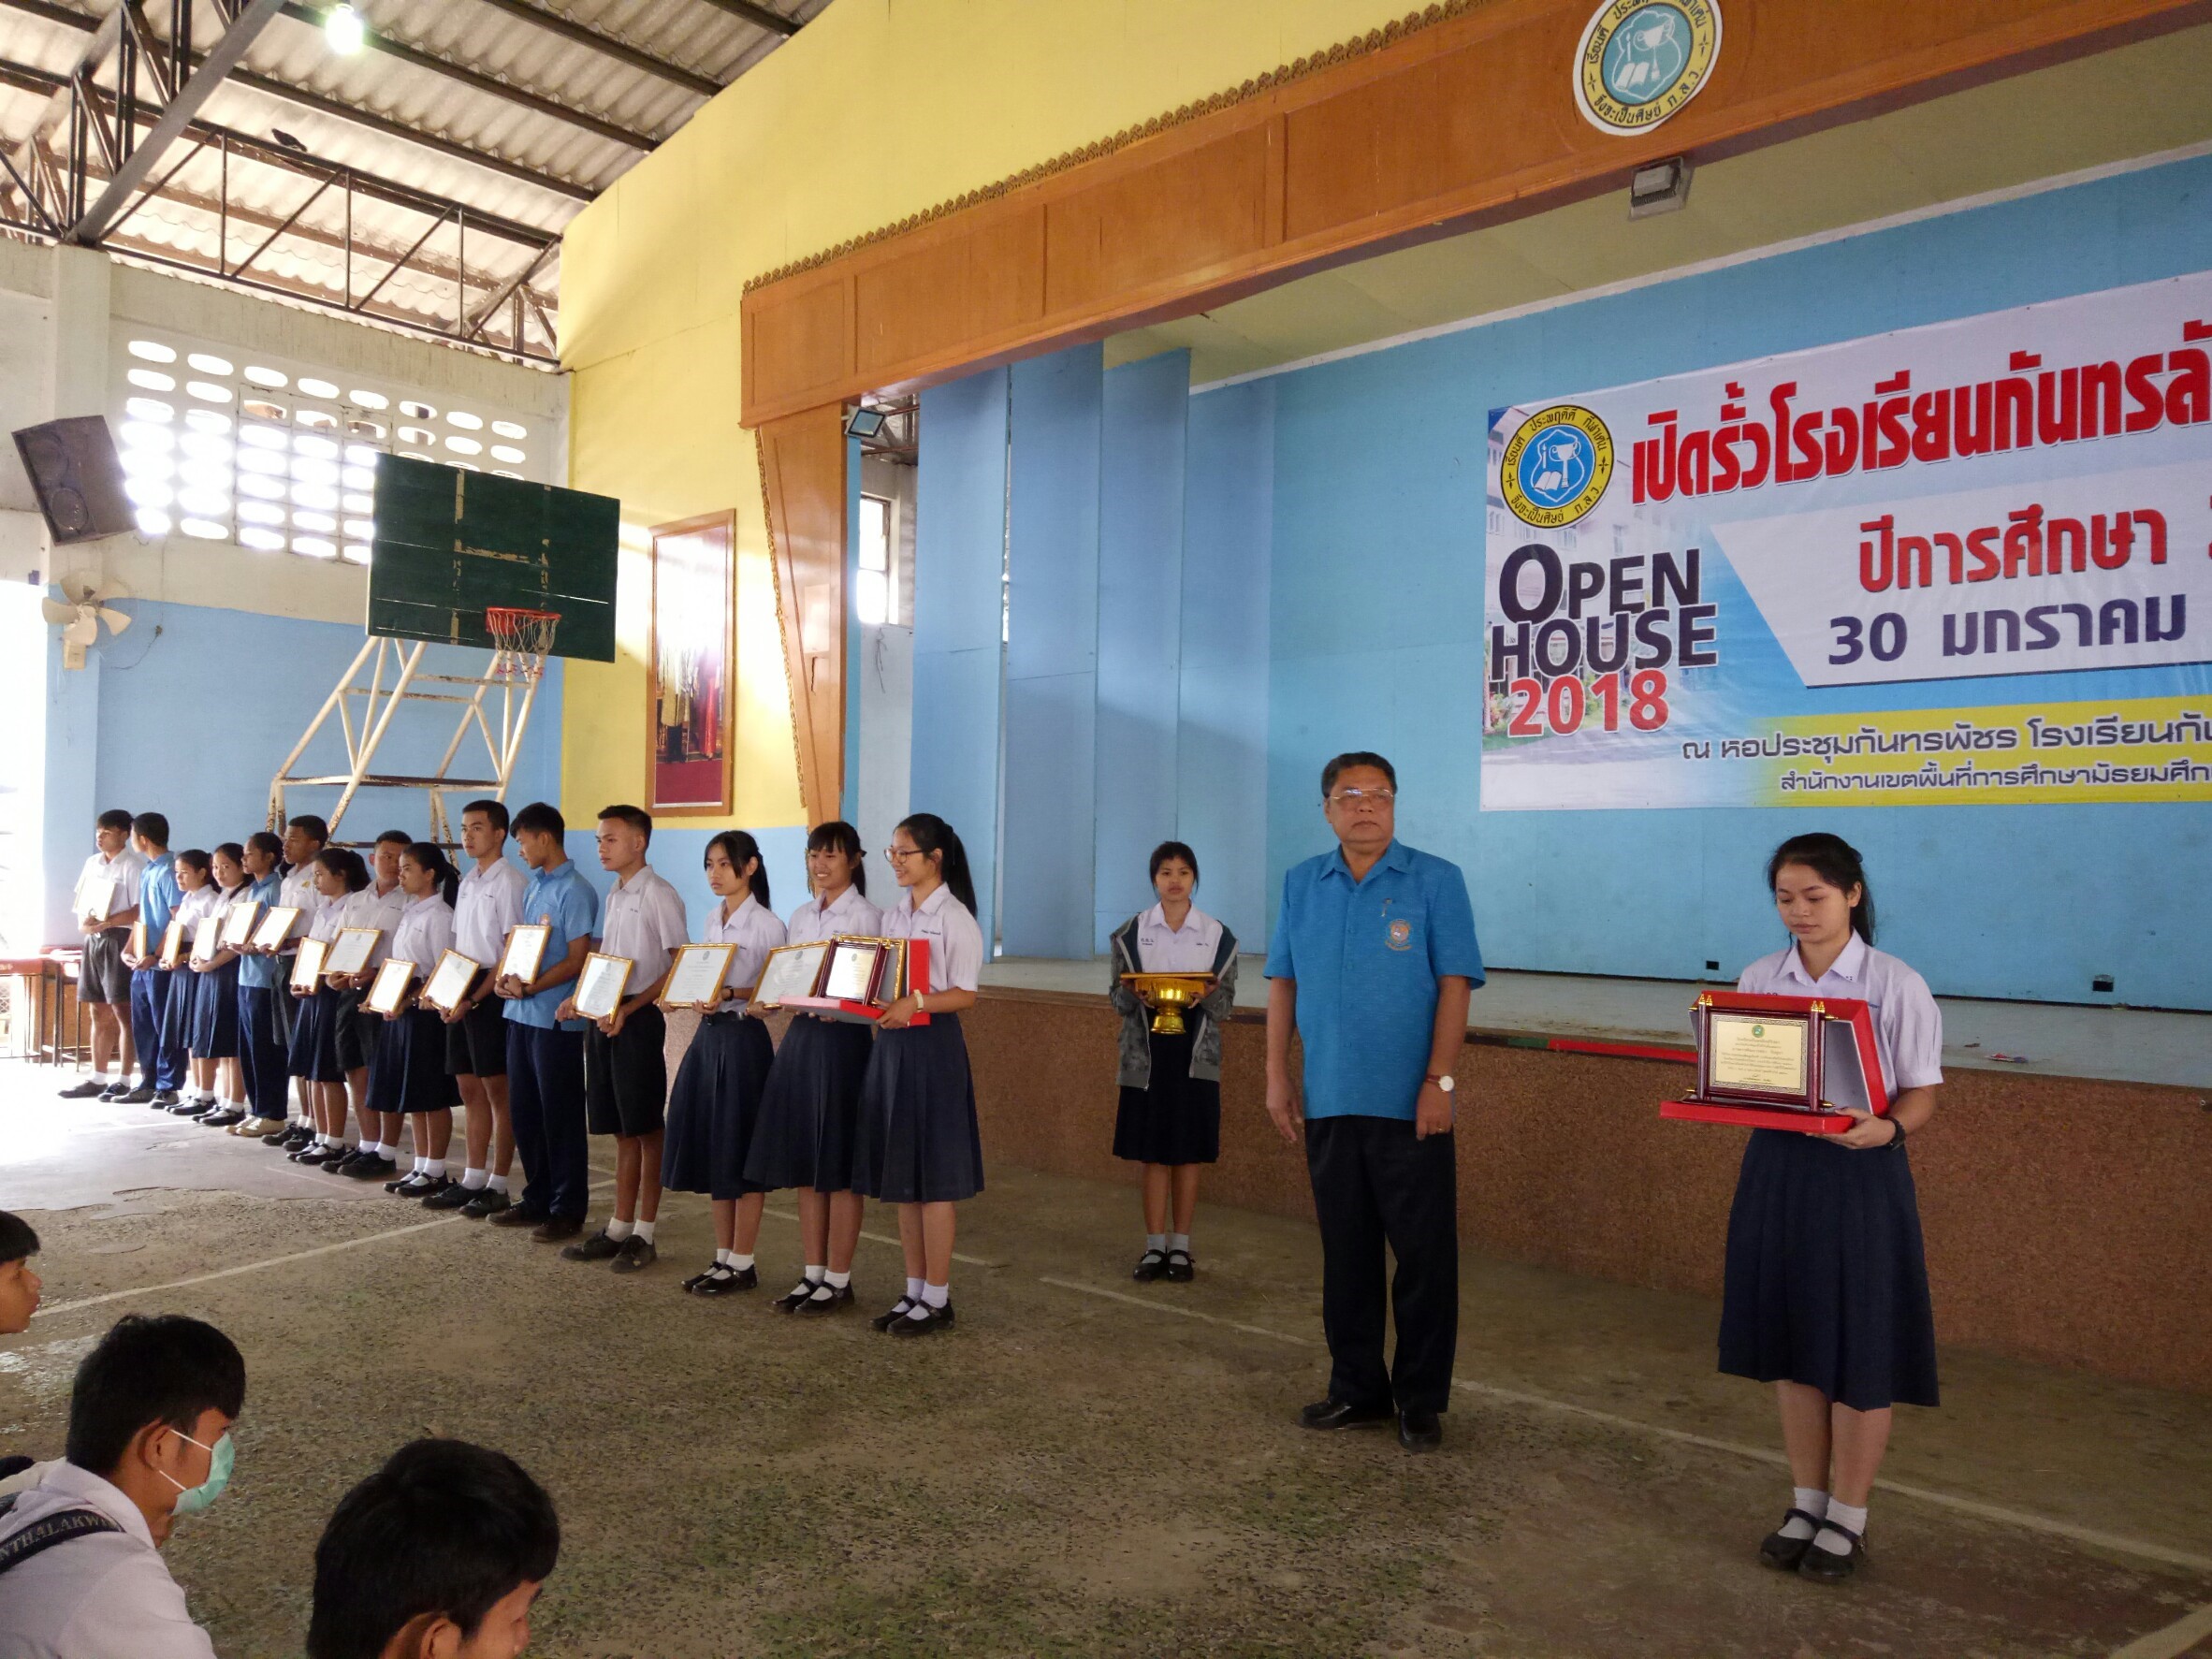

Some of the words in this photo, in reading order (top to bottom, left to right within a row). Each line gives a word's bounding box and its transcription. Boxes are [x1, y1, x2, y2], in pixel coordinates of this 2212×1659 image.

[1859, 502, 2168, 593] ปีการศึกษา
[1491, 604, 1718, 682] HOUSE
[1828, 611, 1908, 665] 30
[1943, 593, 2187, 657] มกราคม
[1507, 668, 1669, 737] 2018
[1682, 740, 1710, 760] ณ
[1781, 759, 2212, 791] สำนักงานเขตพื้นที่การศึกษามัธยมศึก
